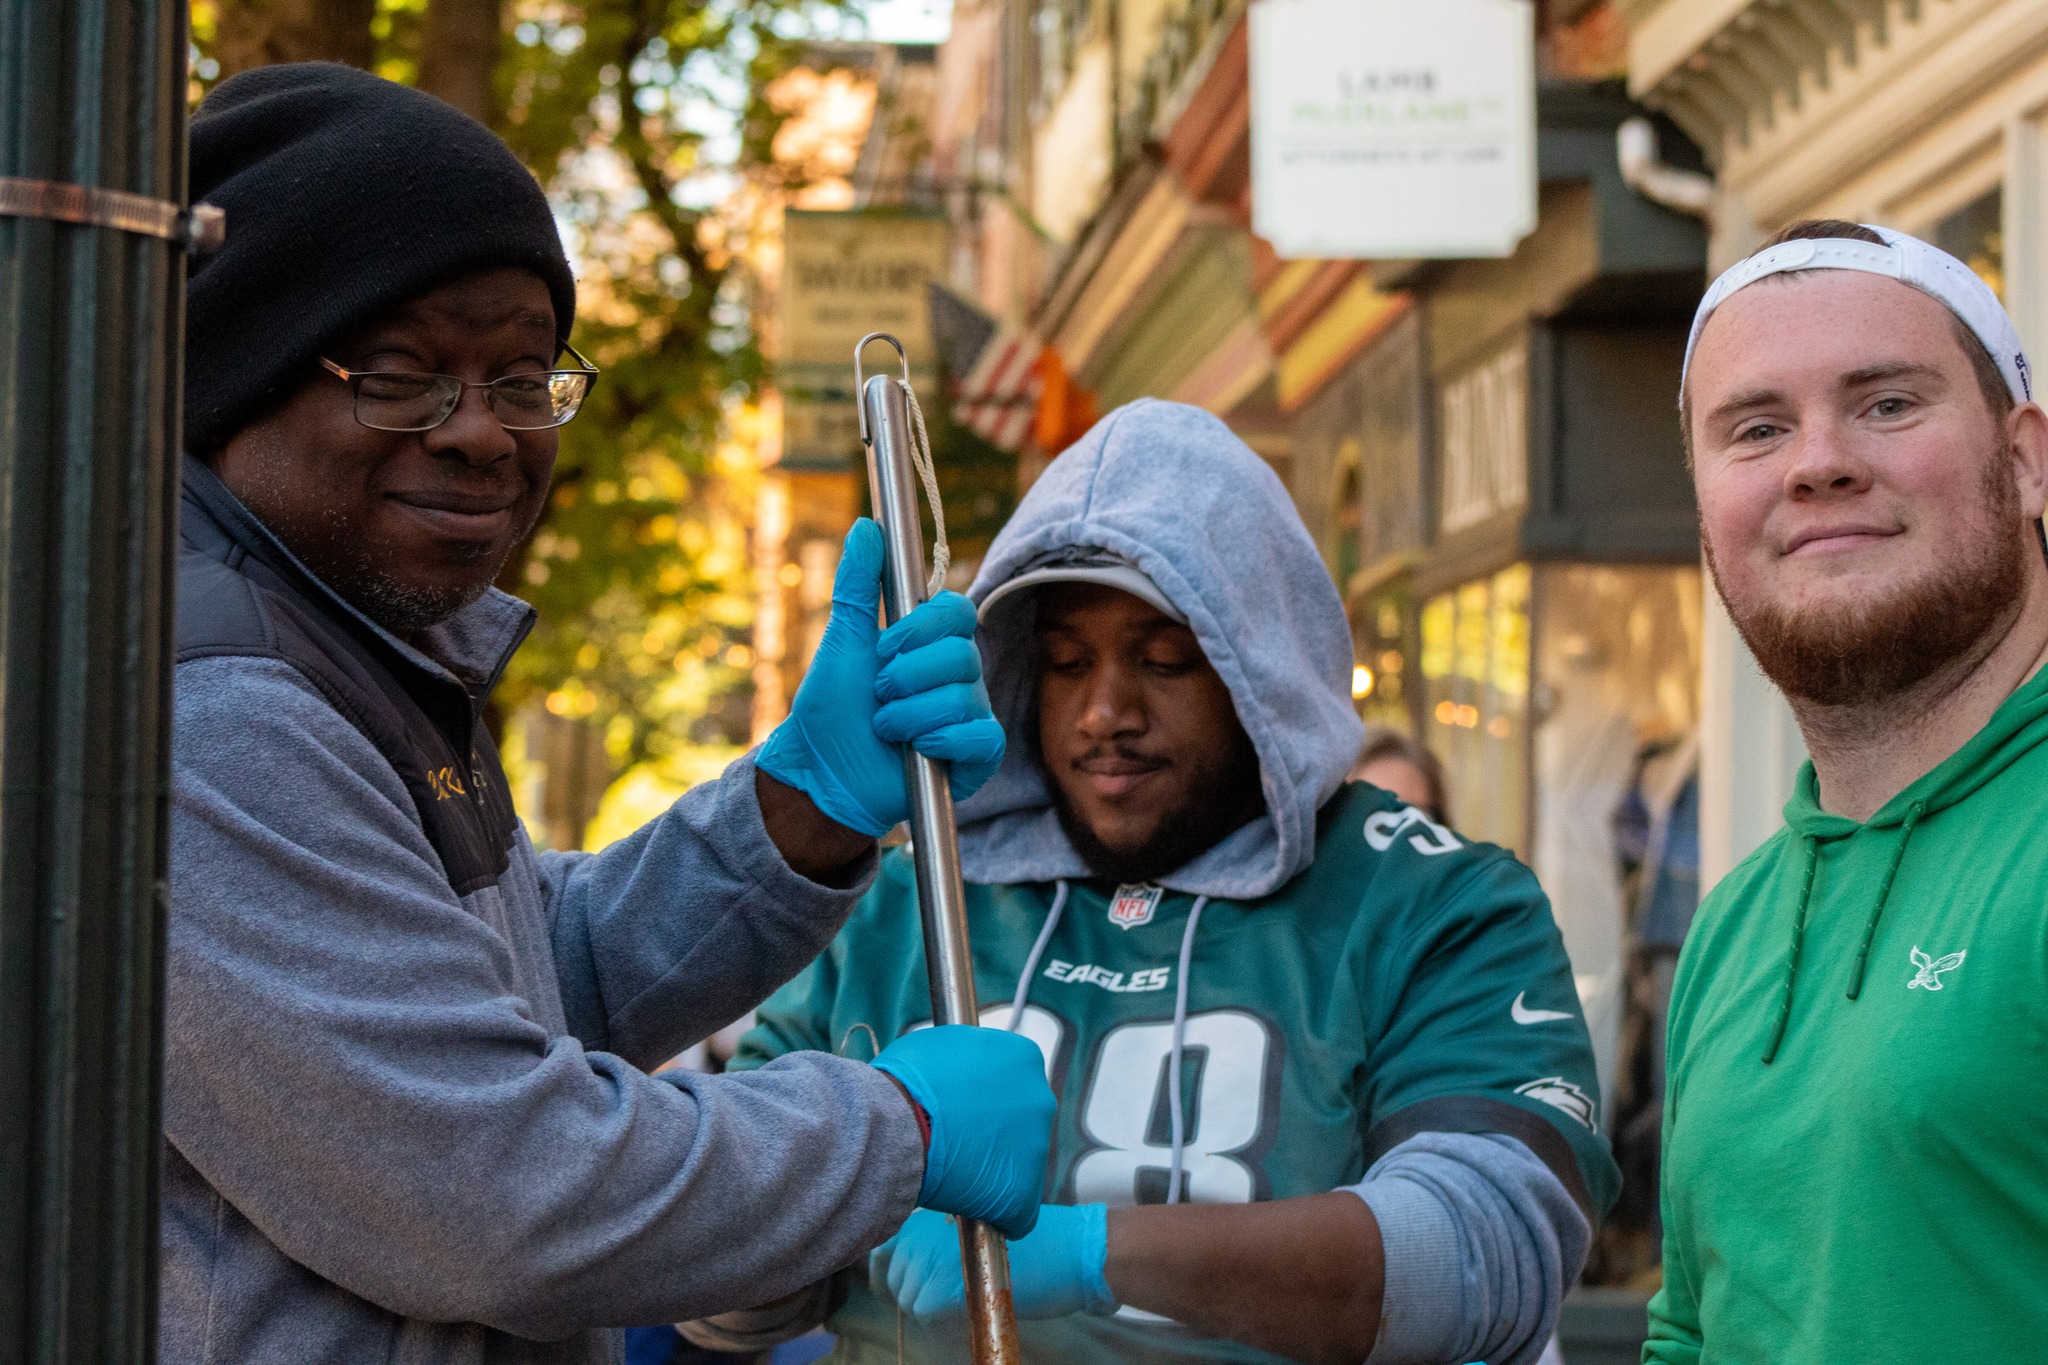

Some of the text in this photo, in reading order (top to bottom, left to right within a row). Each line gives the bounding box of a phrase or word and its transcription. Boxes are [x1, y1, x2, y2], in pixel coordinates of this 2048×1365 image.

[1339, 67, 1438, 96] LAMB
[1115, 897, 1146, 919] NFL
[1043, 959, 1171, 992] EAGLES
